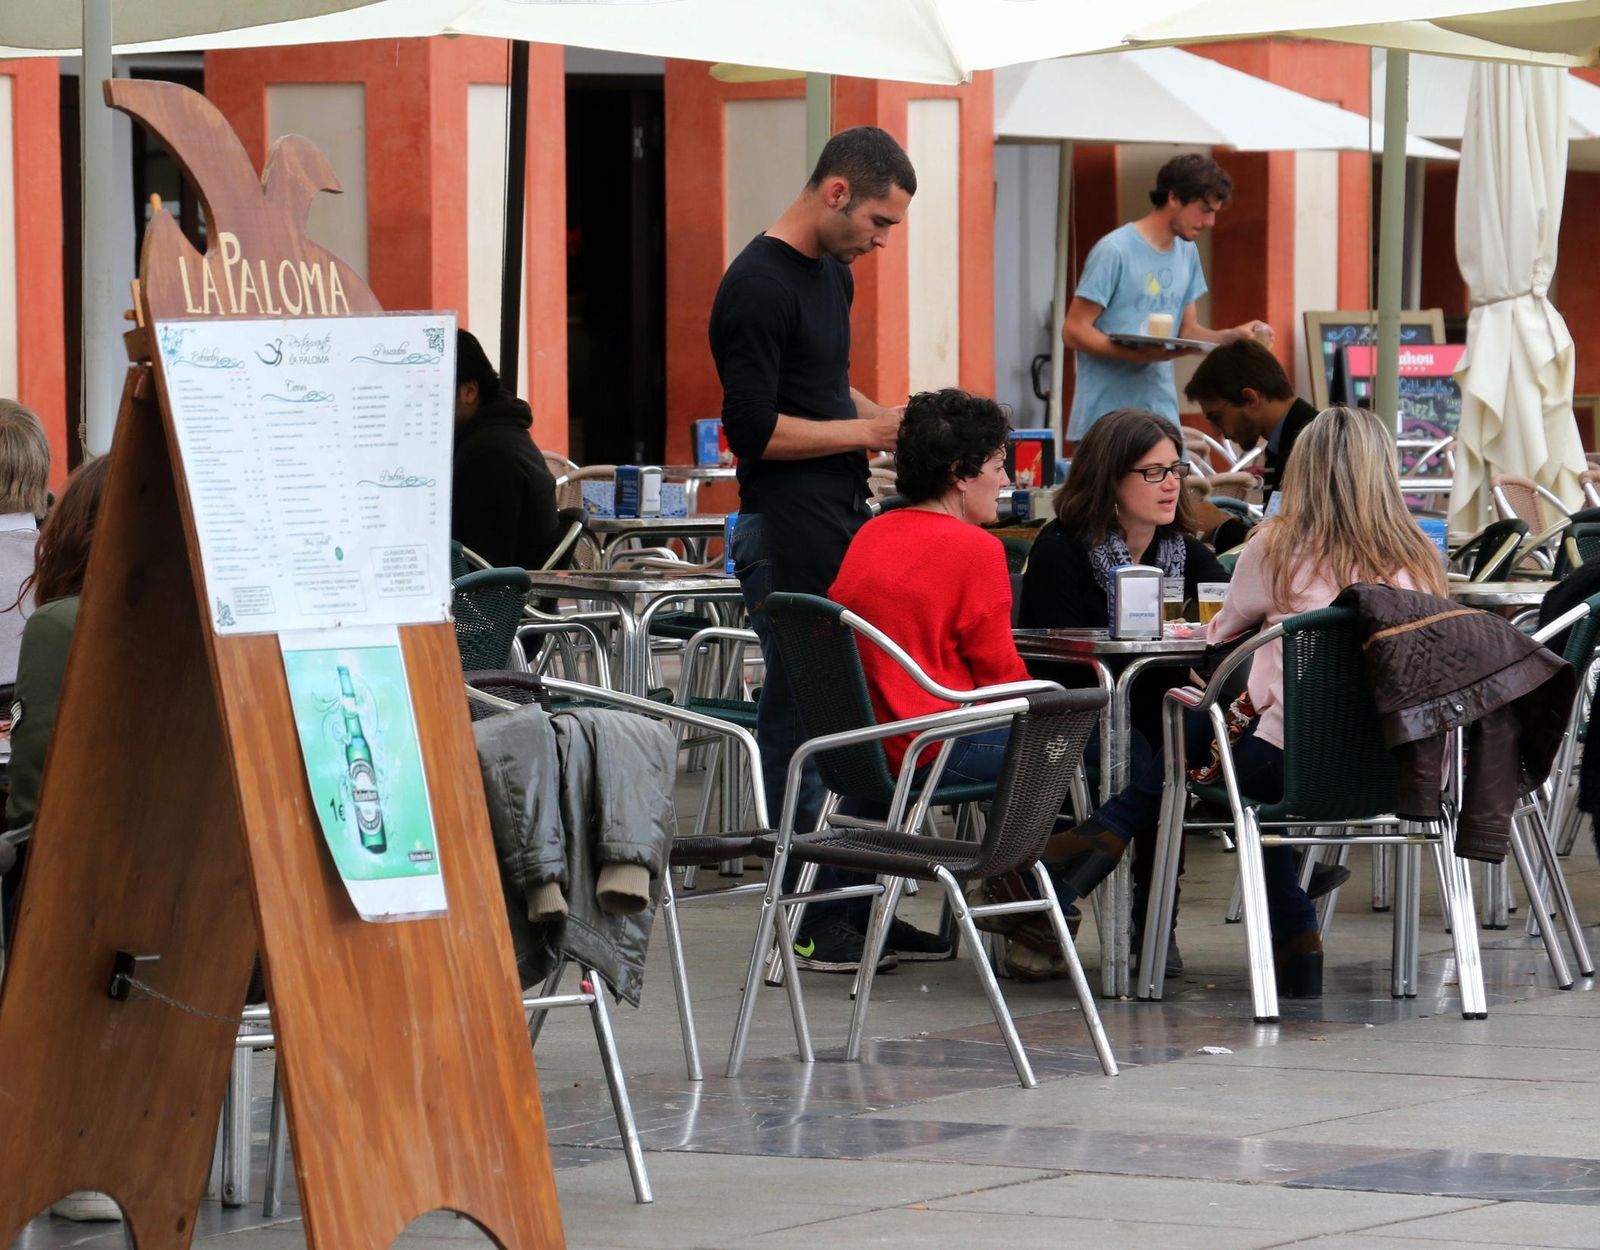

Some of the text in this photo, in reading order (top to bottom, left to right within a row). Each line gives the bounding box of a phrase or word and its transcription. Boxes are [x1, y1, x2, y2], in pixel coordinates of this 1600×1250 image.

[178, 231, 351, 315] LA PALOMA
[300, 355, 330, 365] PALOMA
[1399, 351, 1434, 366] ahou
[330, 797, 346, 821] 1€
